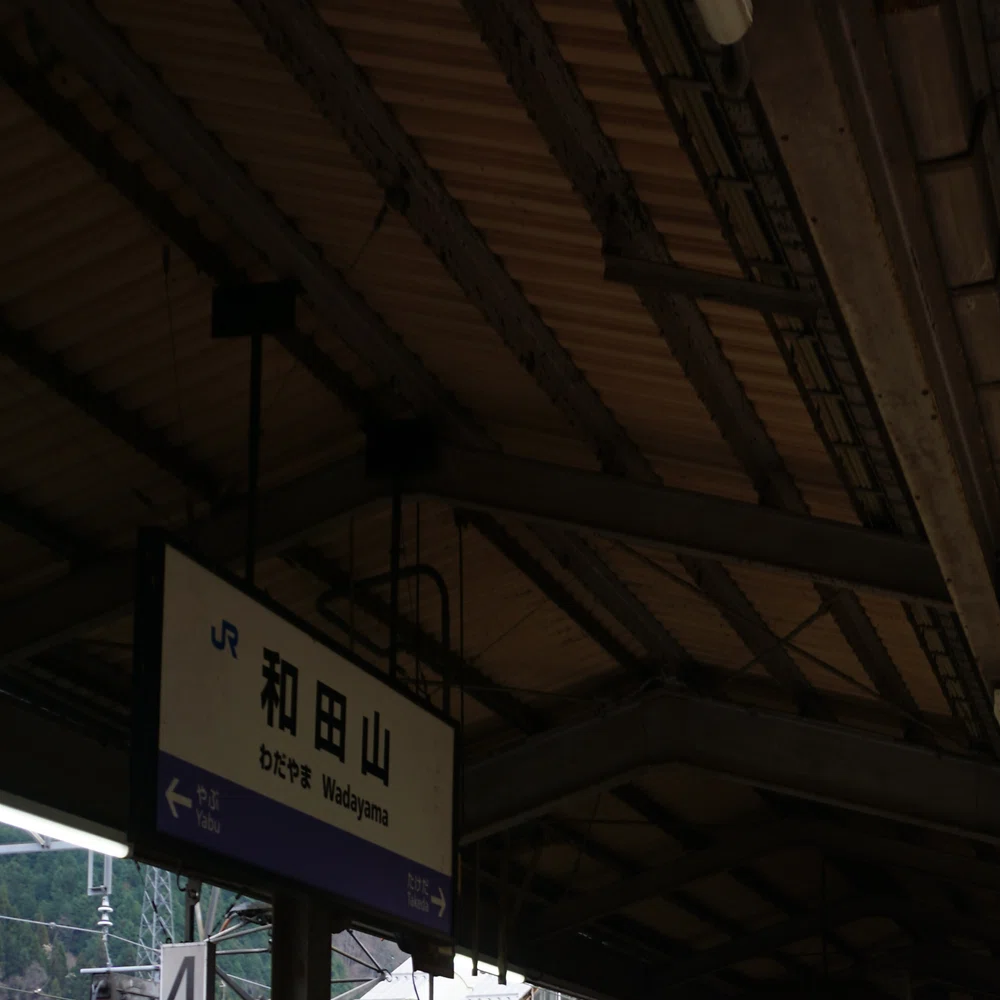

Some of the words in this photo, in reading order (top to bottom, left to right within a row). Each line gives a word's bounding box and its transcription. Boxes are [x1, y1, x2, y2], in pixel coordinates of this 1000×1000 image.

[211, 620, 239, 659] JR
[261, 647, 391, 787] 和田山
[259, 743, 312, 790] わだやま
[196, 783, 221, 813] やぶ
[322, 773, 389, 828] Wadayama
[196, 808, 221, 835] Yabu
[407, 871, 430, 896] たけだ
